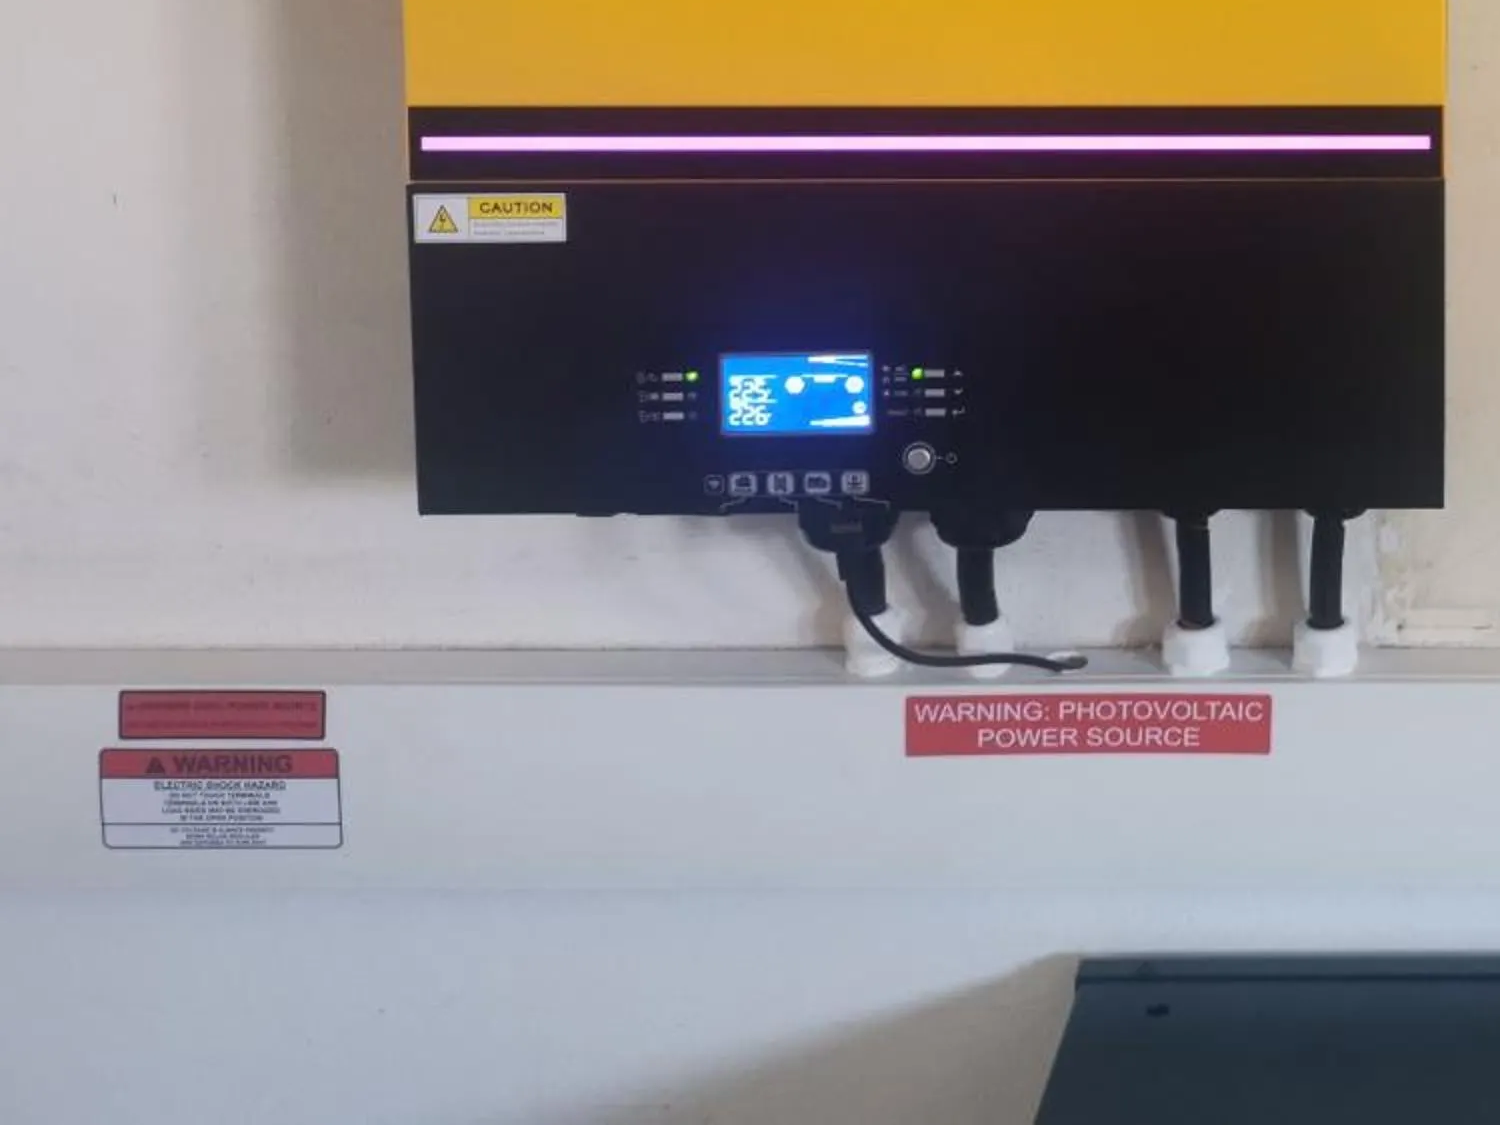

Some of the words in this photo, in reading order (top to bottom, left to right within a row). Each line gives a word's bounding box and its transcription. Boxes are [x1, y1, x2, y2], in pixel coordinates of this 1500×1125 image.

[479, 201, 553, 214] CAUTION
[914, 701, 1050, 723] WARNING:
[1058, 700, 1264, 722] PHOTOVOLTAIC
[977, 727, 1079, 748] POWER
[1086, 726, 1201, 747] SOURCE
[173, 754, 294, 774] WARNING
